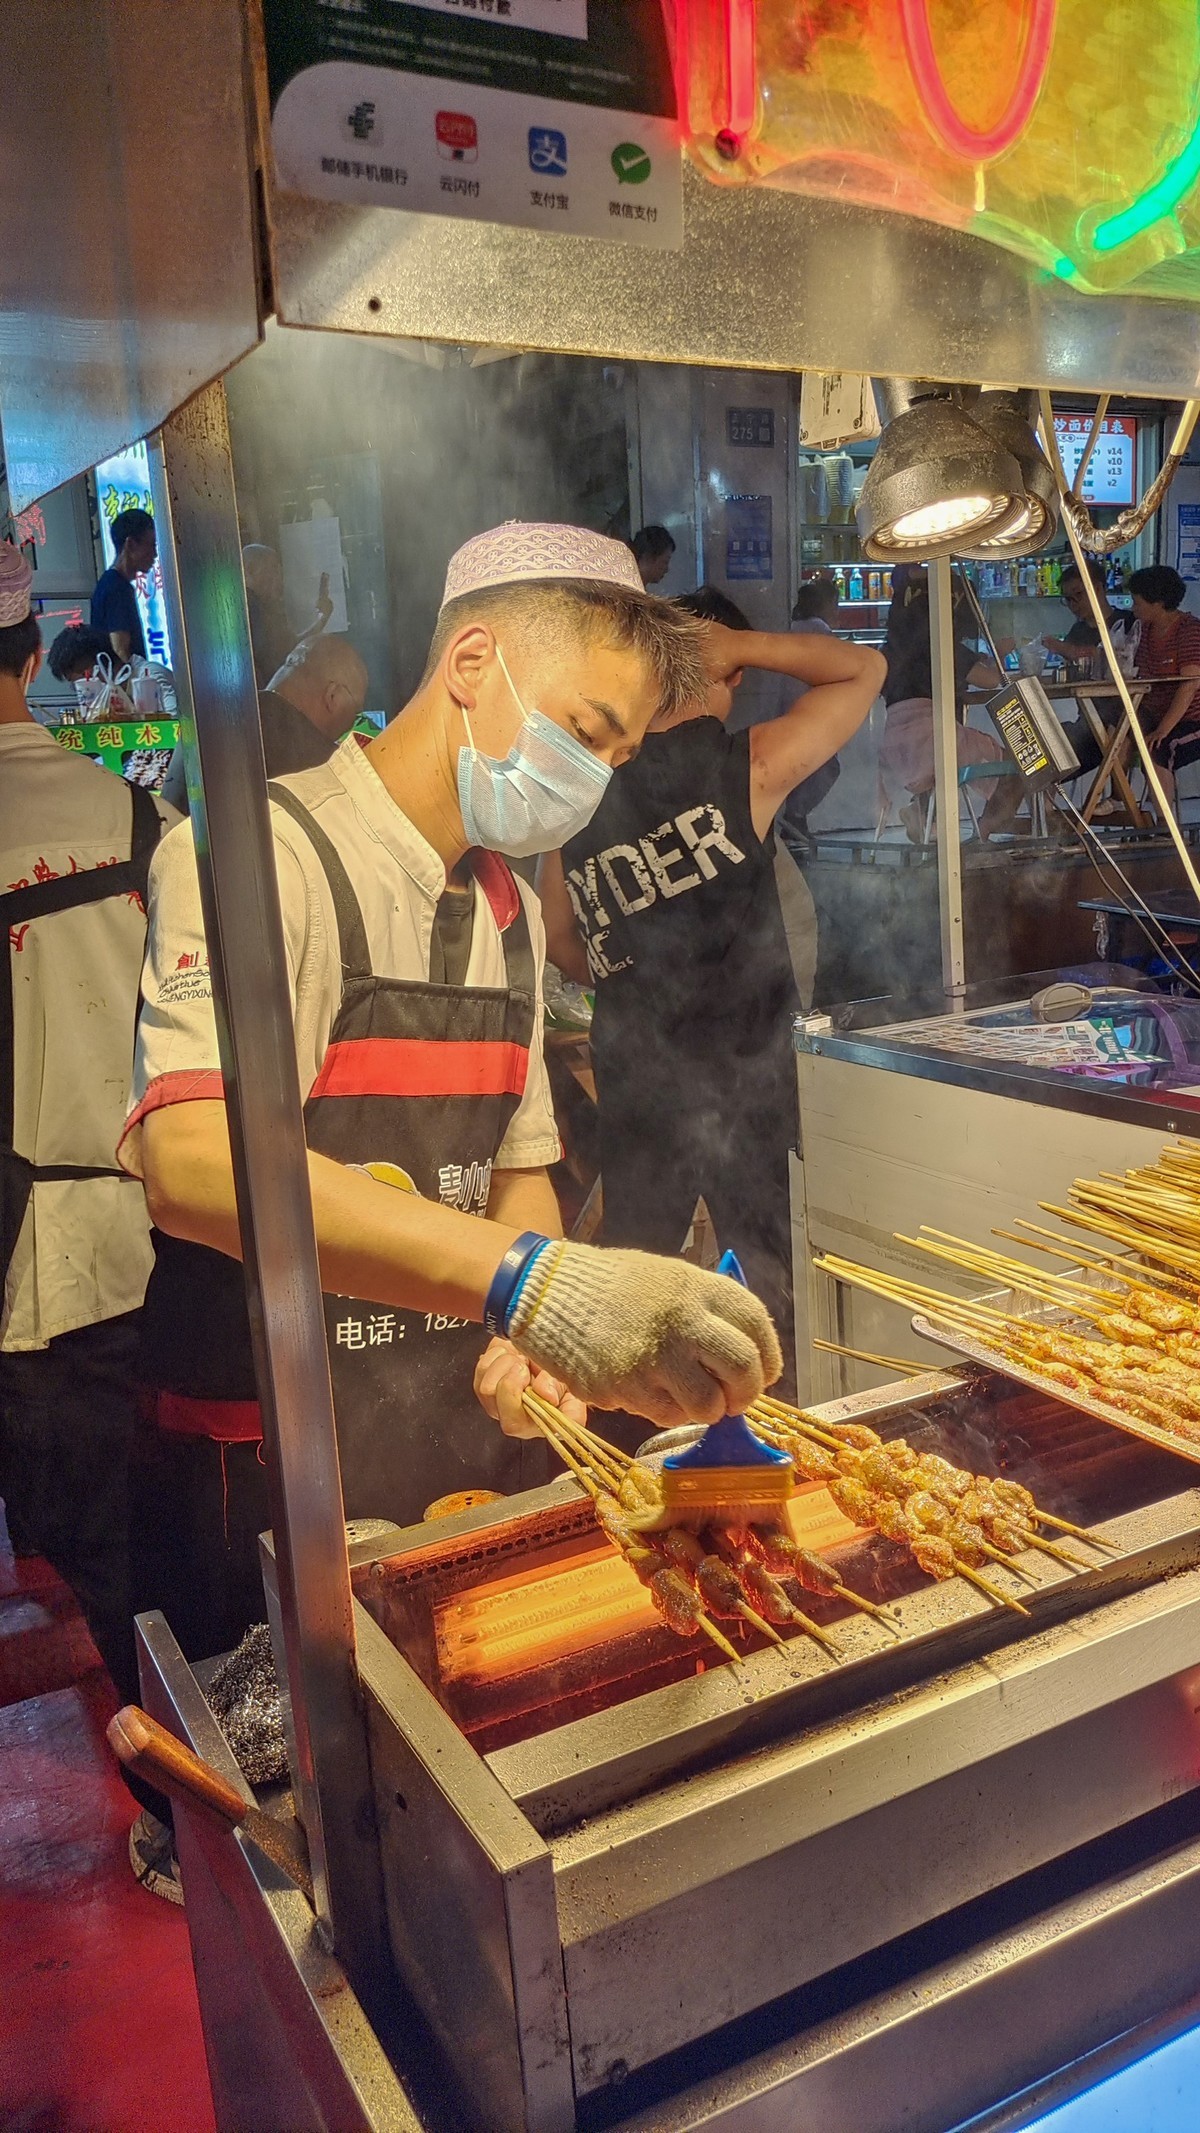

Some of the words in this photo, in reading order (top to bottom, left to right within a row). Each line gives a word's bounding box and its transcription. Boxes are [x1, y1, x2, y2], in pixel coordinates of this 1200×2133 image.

[440, 176, 480, 198] 云闪付
[530, 190, 569, 211] 支付宝
[609, 201, 658, 223] 微信支付
[175, 951, 209, 971] 創
[335, 1313, 406, 1350] 电话：
